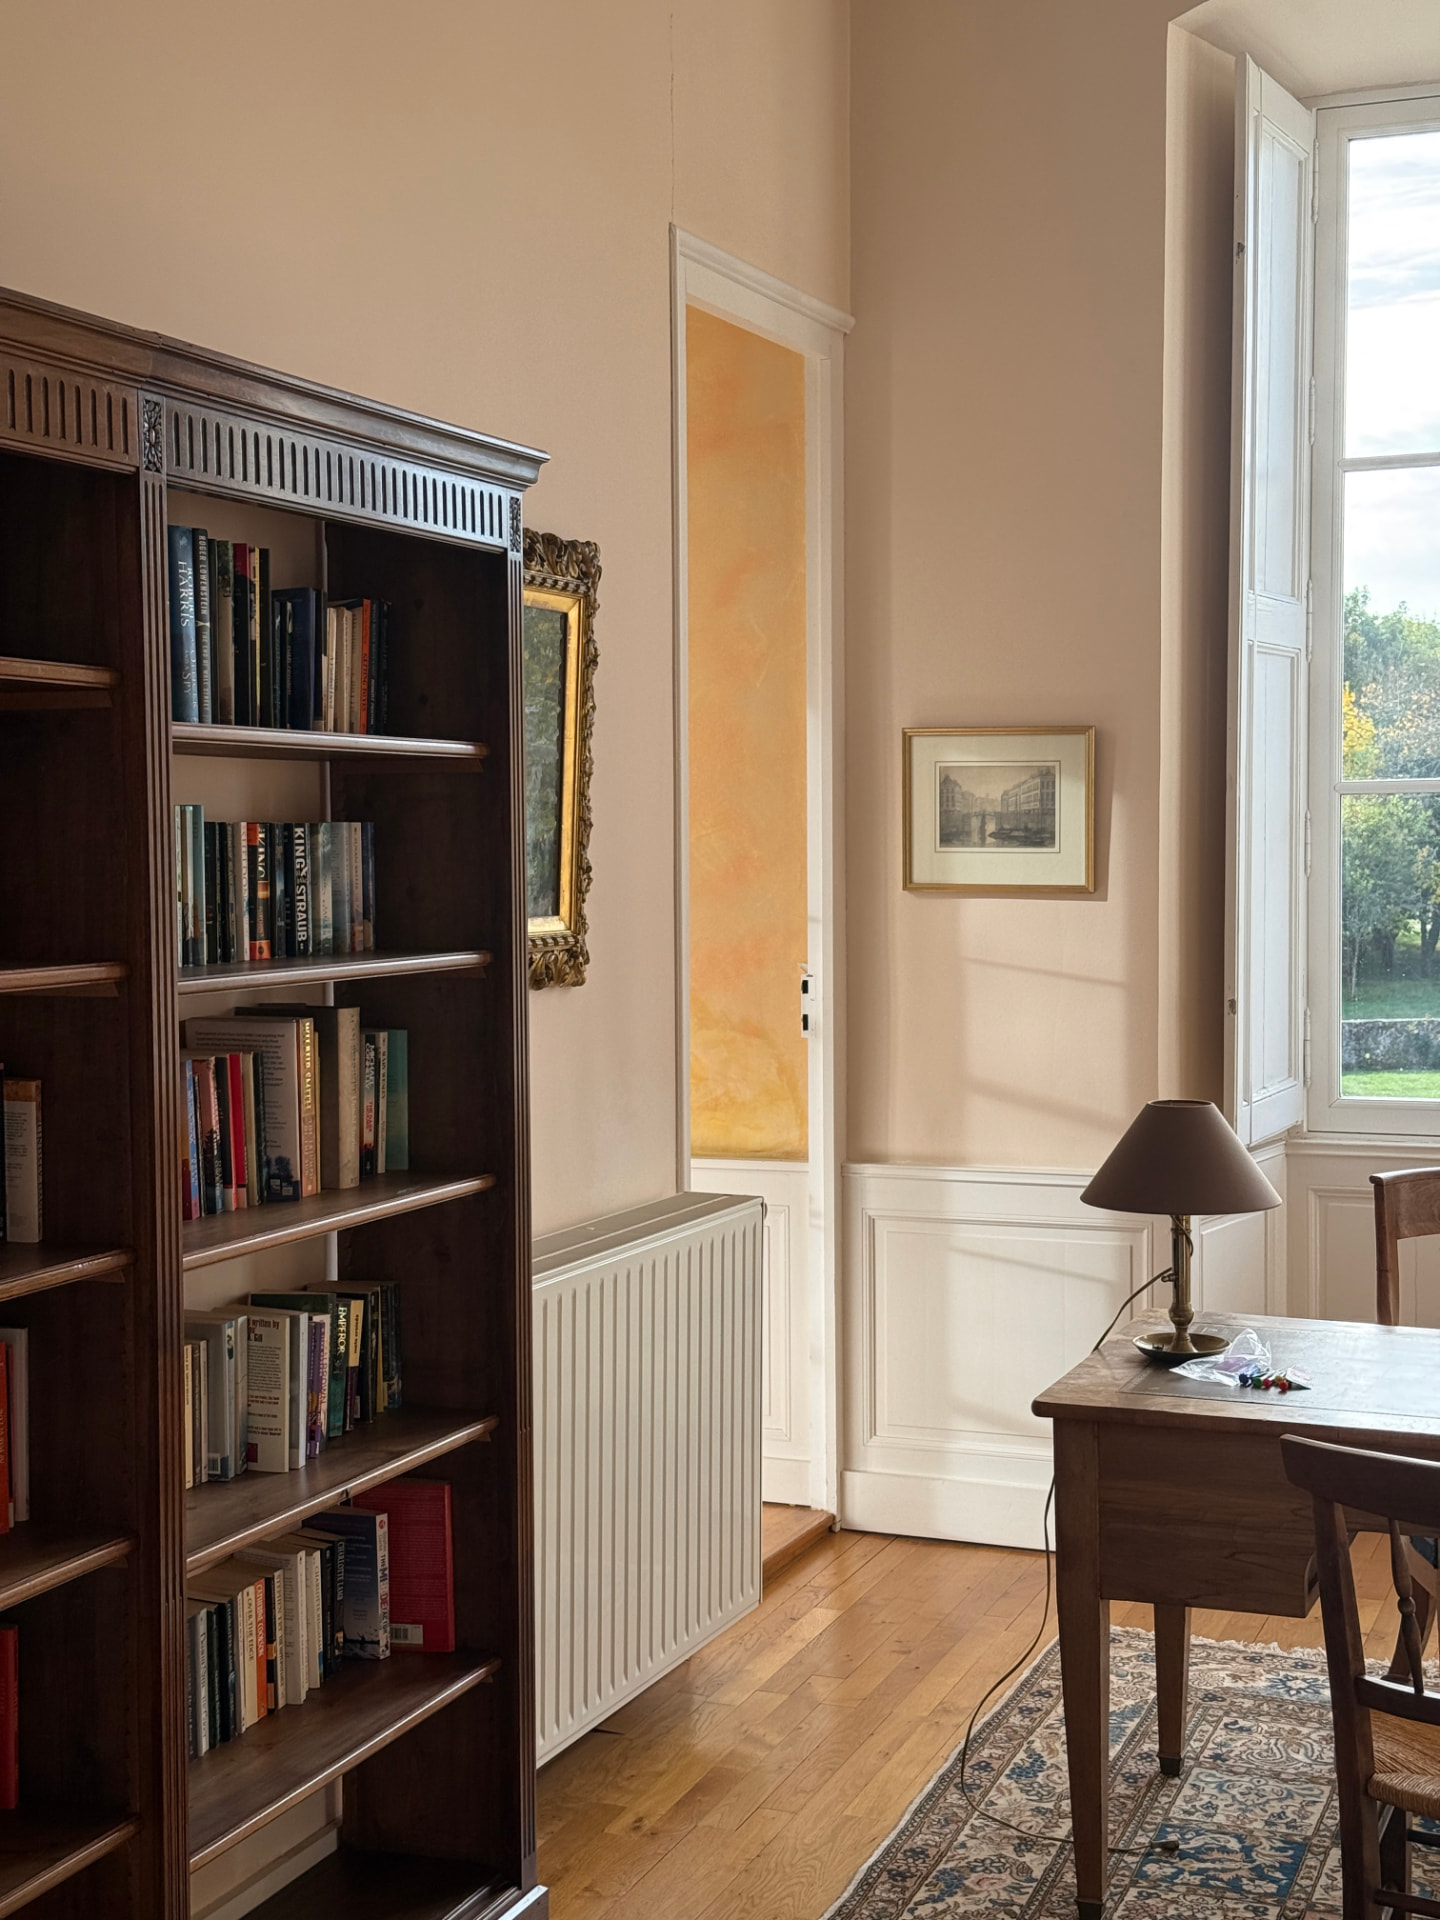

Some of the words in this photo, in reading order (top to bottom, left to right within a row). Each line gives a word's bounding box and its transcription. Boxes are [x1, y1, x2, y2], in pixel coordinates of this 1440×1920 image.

[178, 561, 189, 627] HARRIS
[182, 671, 191, 695] SPY
[294, 827, 305, 869] KING
[296, 885, 308, 941] STRAUB
[304, 1021, 312, 1069] WILBUR
[304, 1072, 312, 1111] SMITH
[252, 1319, 271, 1329] written
[273, 1320, 280, 1330] by
[337, 1307, 348, 1354] EMPEROR
[337, 1541, 345, 1582] CHARLOTTE
[256, 1584, 264, 1621] CATHERINE
[257, 1622, 265, 1657] COOKSON
